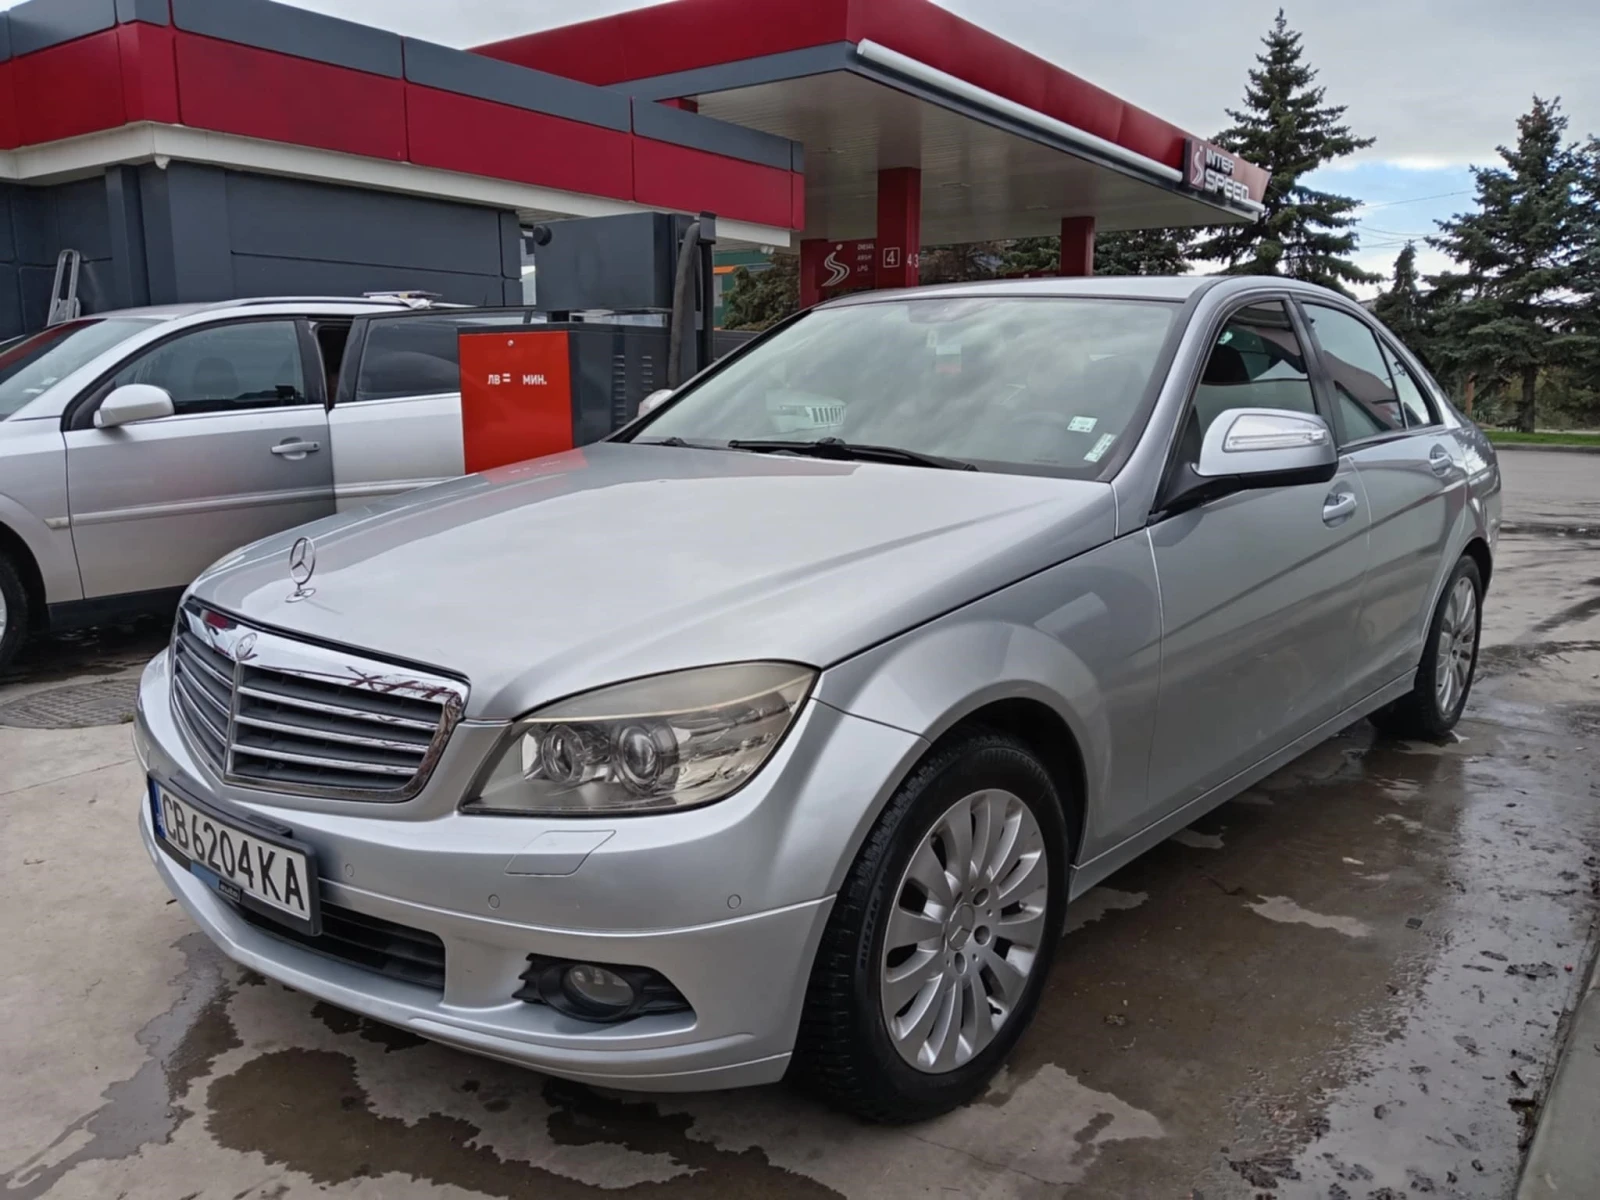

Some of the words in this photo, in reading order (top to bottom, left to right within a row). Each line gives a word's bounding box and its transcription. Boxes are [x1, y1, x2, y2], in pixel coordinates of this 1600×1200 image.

[1206, 148, 1235, 175] INTER
[1205, 168, 1249, 201] SPEED
[886, 250, 896, 265] 4
[522, 374, 547, 385] МИН.
